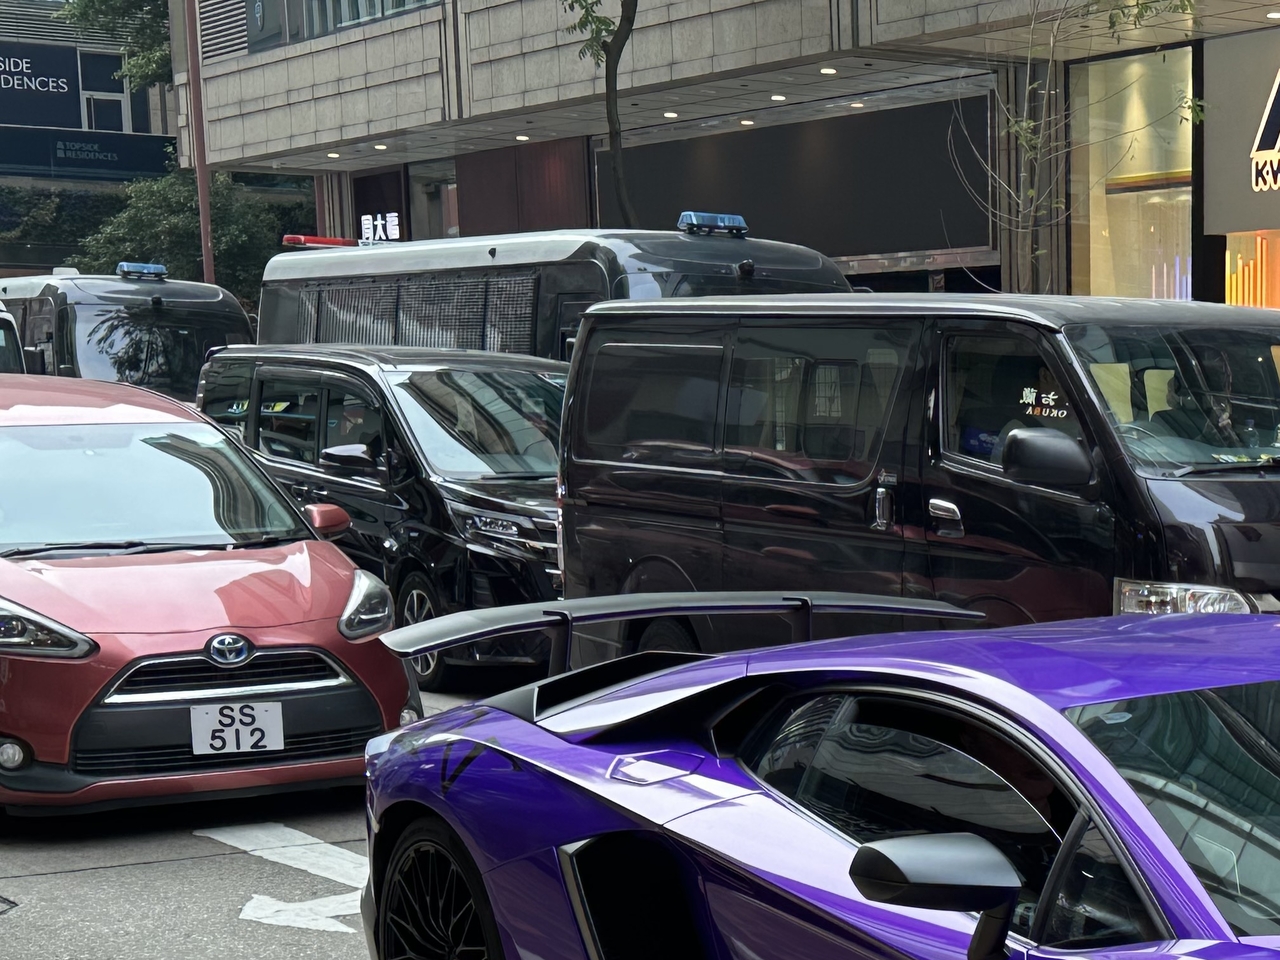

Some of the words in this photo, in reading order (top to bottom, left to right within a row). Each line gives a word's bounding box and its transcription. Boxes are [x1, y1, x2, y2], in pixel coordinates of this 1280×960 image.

[66, 141, 100, 151] TOPSIDE
[66, 150, 119, 161] RESIDENCES
[218, 704, 257, 728] SS
[209, 727, 268, 752] 512
